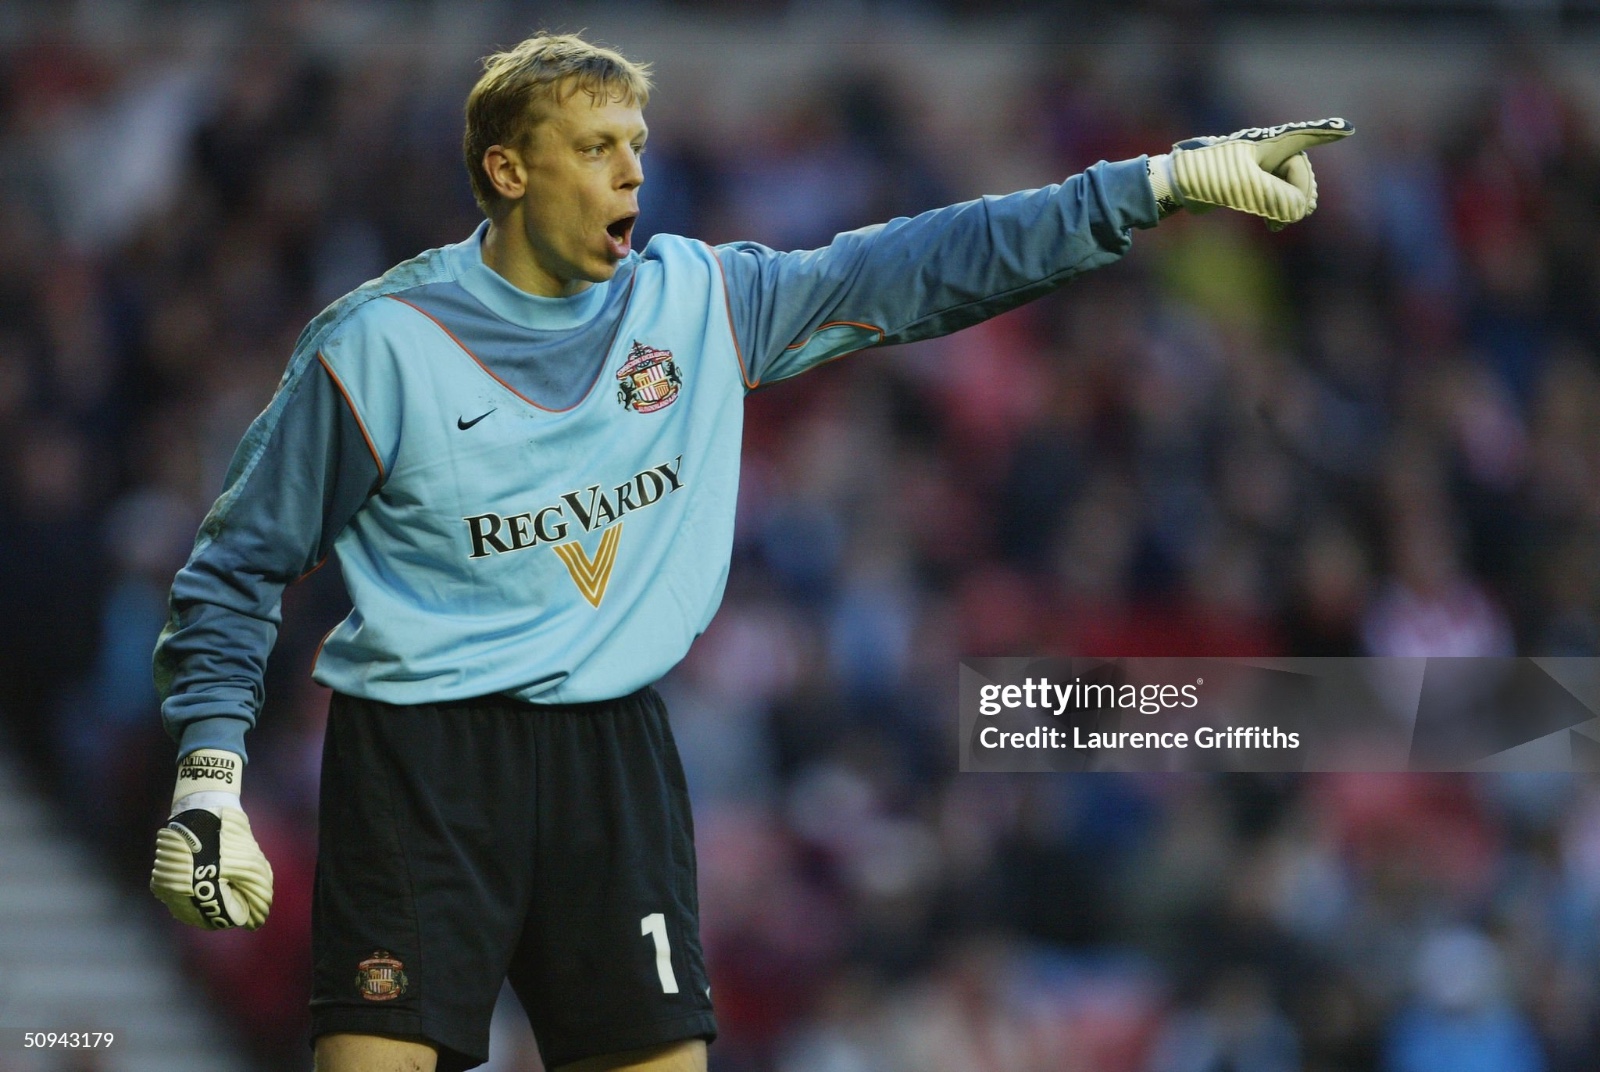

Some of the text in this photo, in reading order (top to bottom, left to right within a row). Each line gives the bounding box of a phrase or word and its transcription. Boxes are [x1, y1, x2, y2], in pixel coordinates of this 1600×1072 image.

[463, 454, 685, 559] REG VARDY
[640, 912, 680, 994] 1
